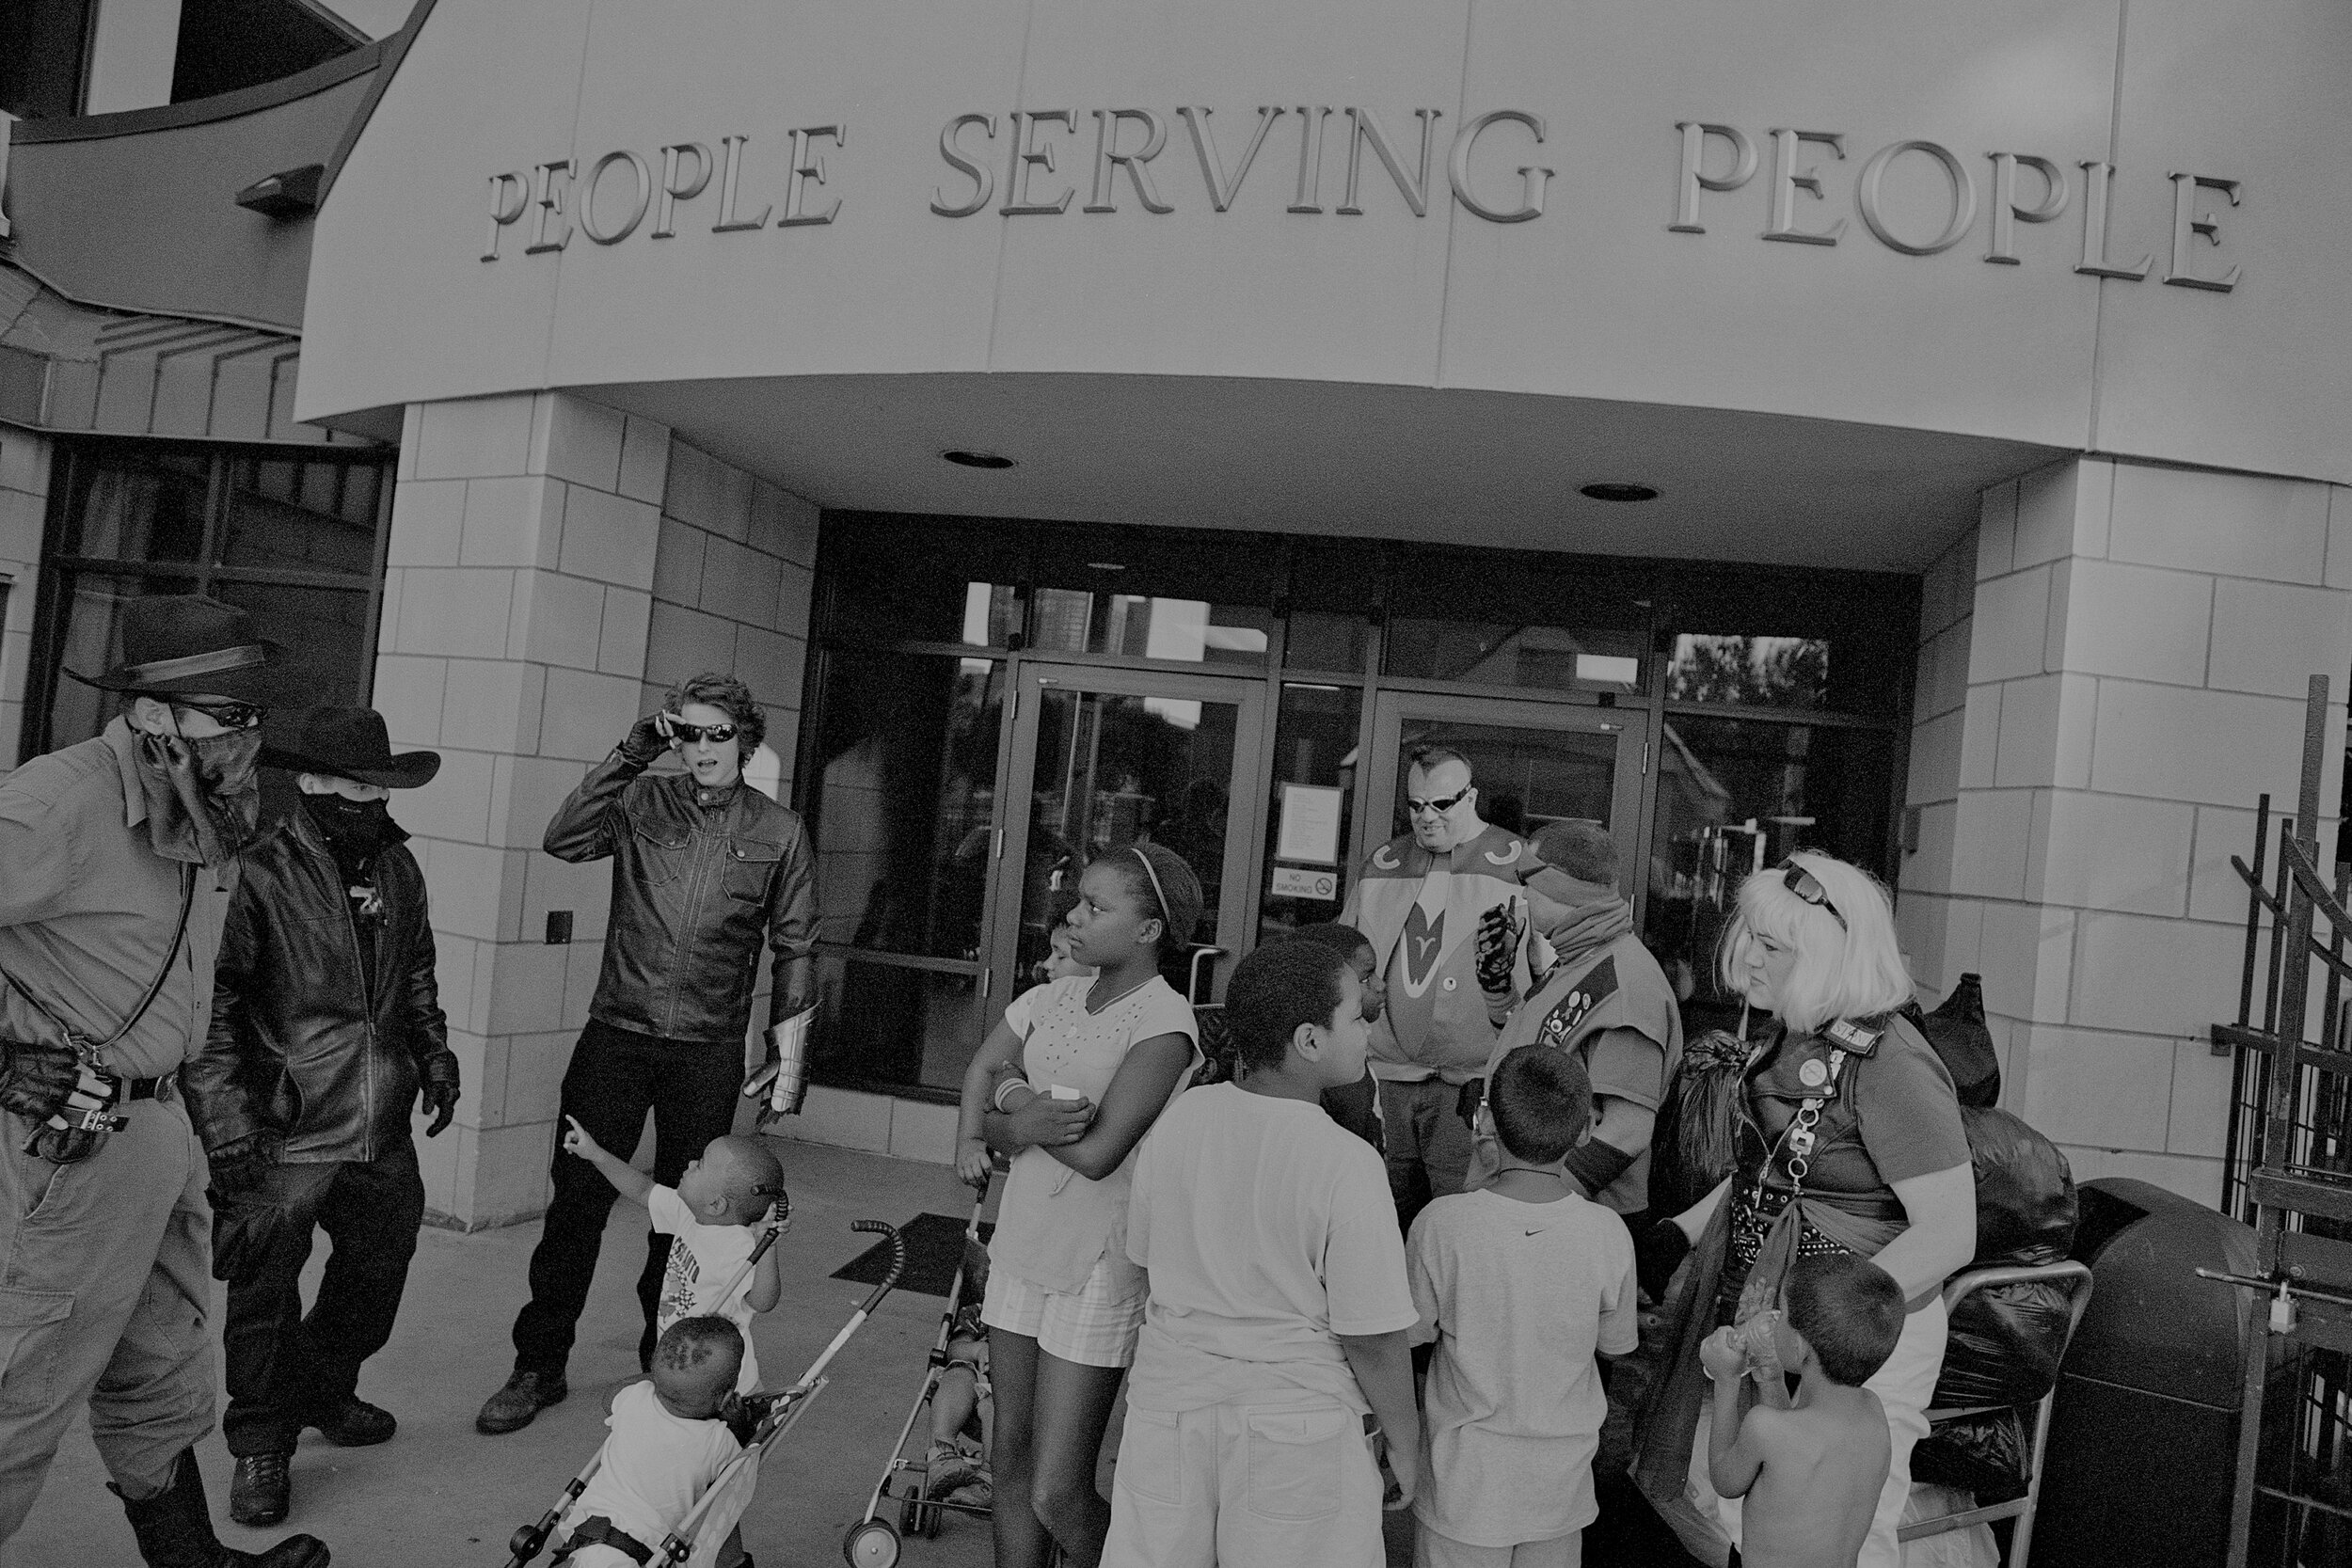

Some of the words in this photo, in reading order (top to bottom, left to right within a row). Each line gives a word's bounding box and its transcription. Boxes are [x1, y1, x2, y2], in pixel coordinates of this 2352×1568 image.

[480, 124, 846, 263] PEOPLE
[930, 105, 1556, 224] SERVING
[1666, 119, 2243, 293] PEOPLE
[1289, 874, 1301, 882] NO
[1276, 882, 1312, 895] SMOKING
